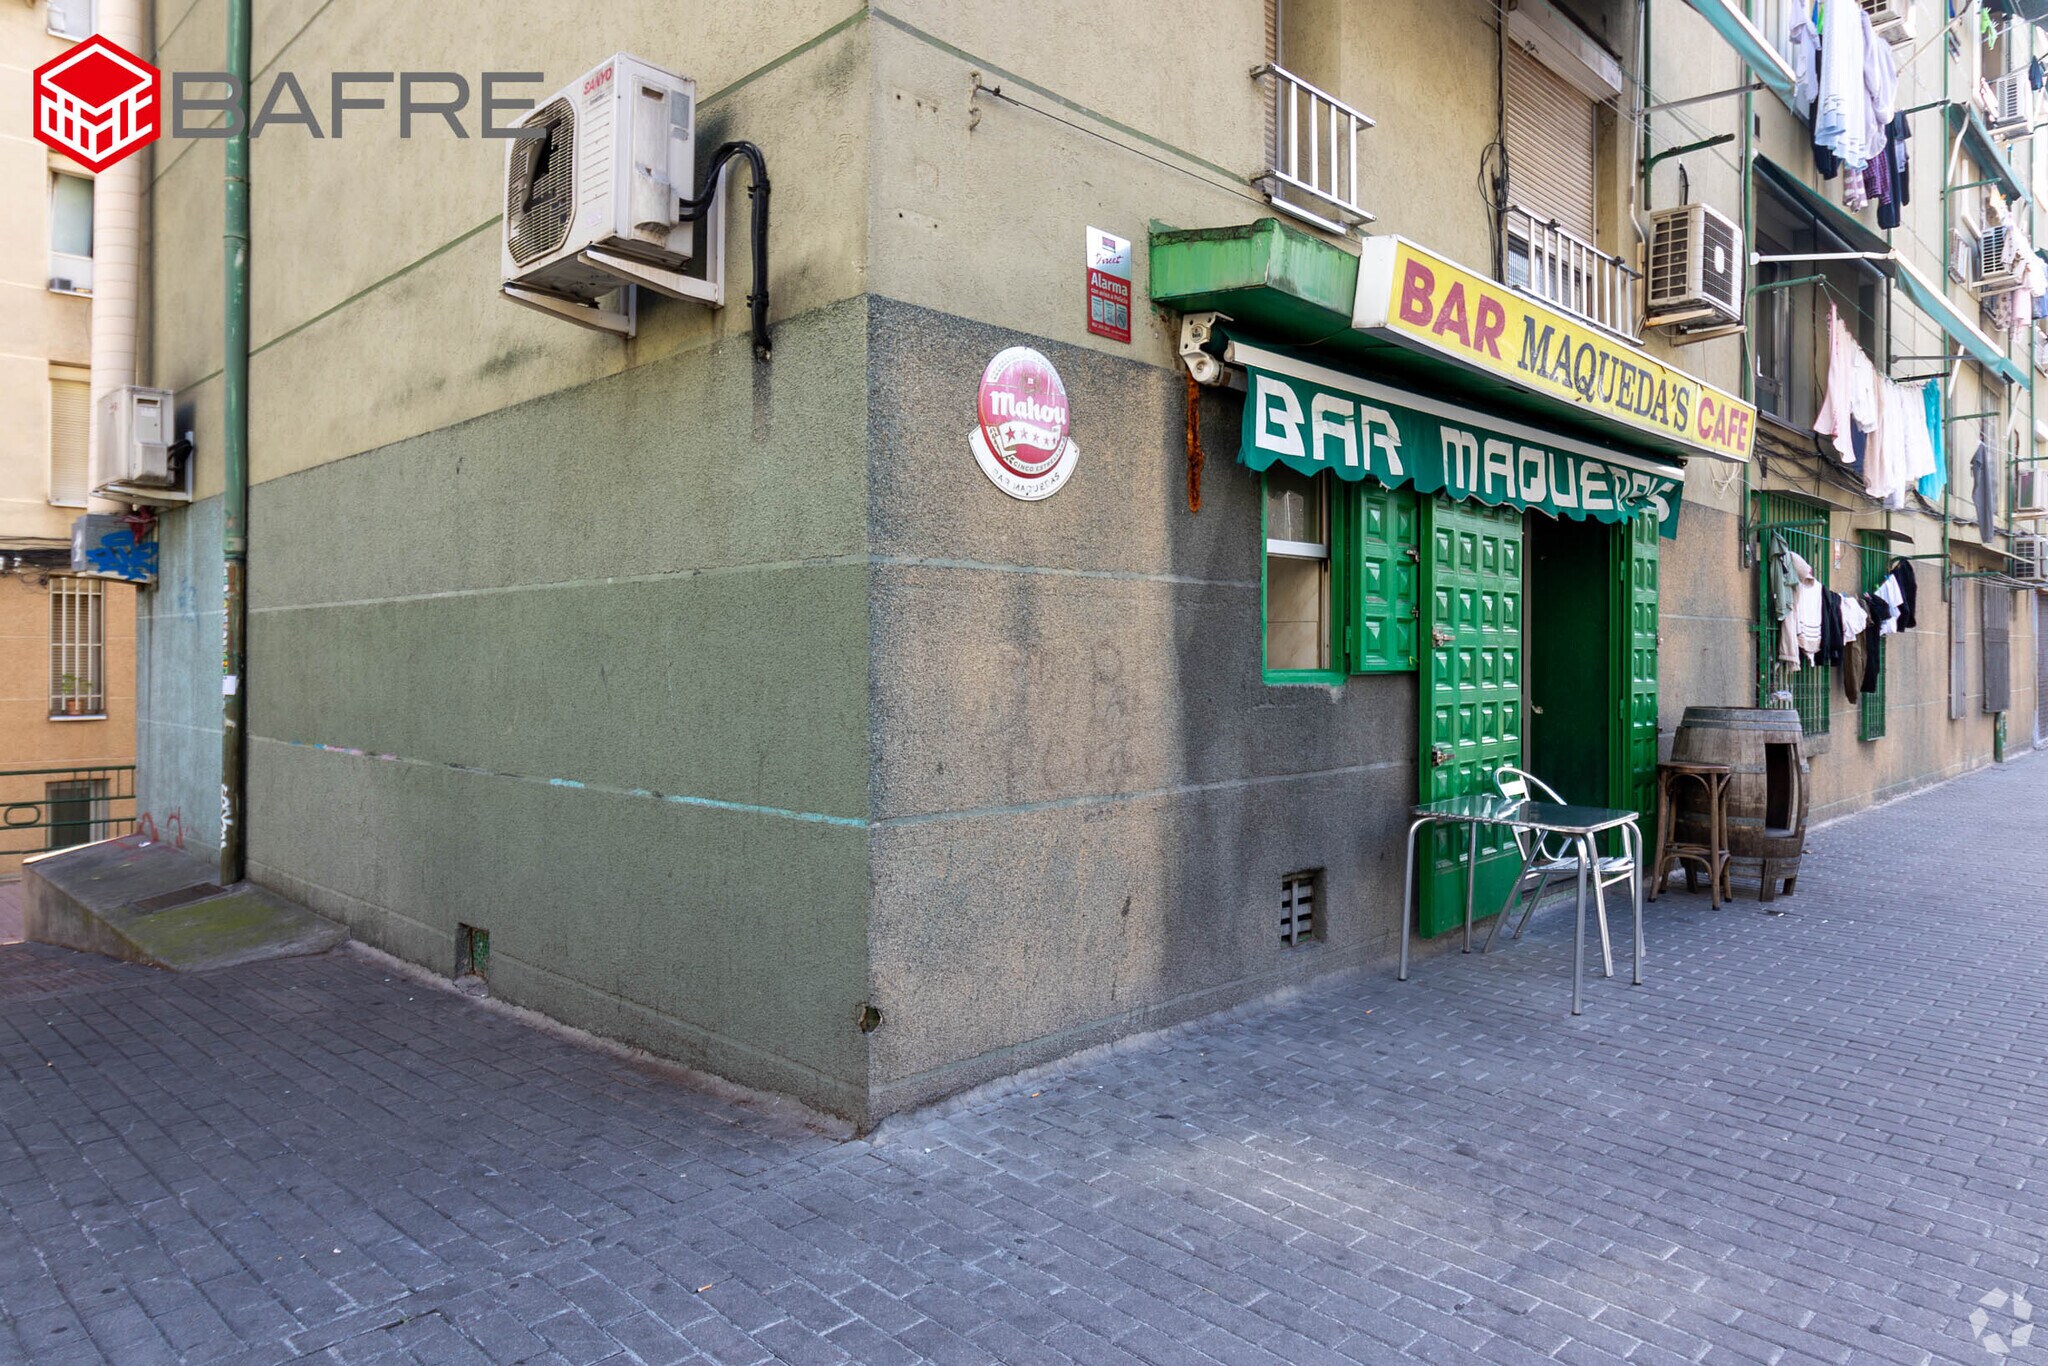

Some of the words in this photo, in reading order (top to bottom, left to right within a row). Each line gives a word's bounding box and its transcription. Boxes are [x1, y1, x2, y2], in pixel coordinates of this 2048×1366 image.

[583, 67, 612, 95] SANYO
[1091, 272, 1128, 297] Alarma
[1400, 258, 1506, 360] BAR
[1517, 314, 1691, 432] MAQUEDA'S
[1697, 396, 1749, 452] CAFE
[990, 391, 1066, 425] Mahou
[1255, 374, 1404, 476] BAR
[1013, 460, 1034, 472] CINCO
